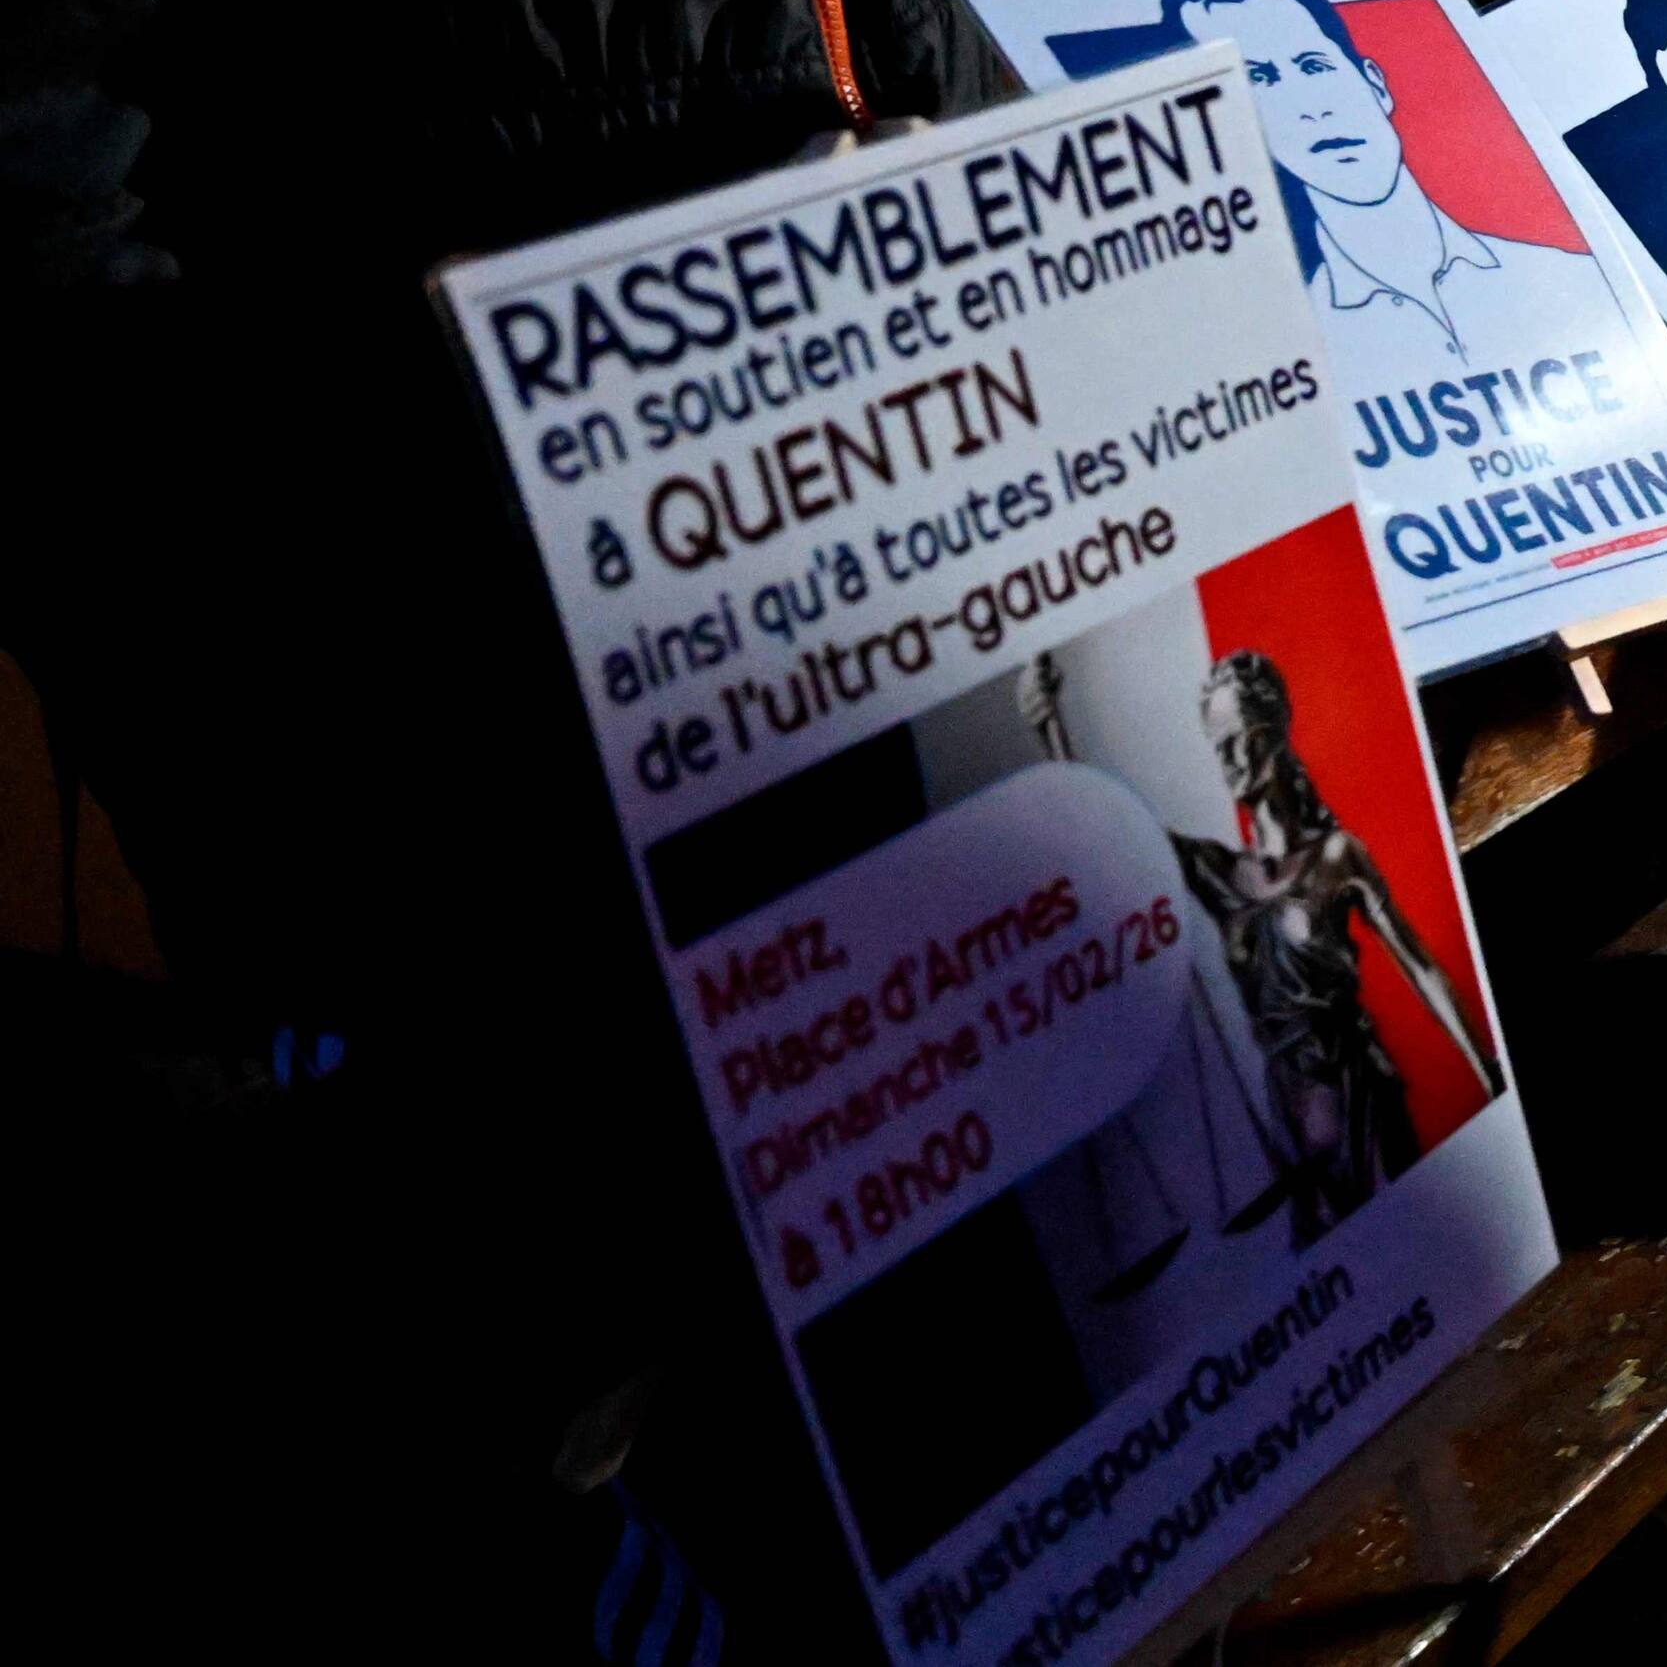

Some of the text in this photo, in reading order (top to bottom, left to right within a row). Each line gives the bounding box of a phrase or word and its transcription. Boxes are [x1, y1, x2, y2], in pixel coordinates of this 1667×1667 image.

[490, 87, 1225, 408] RASSEMBLEMENT
[542, 187, 1257, 484] en soutien et en hommage
[589, 349, 1038, 587] à QUENTIN
[605, 358, 1318, 704] ainsi qu'à toutes les victimes
[1354, 350, 1624, 469] JUSTICE
[1468, 442, 1554, 483] POUR
[636, 505, 1174, 793] de l'ultra-gauche
[695, 919, 846, 1028] Metz
[723, 875, 1081, 1112] Place d'Armes
[747, 895, 1179, 1195] Dimanche 15/02/26
[781, 1112, 990, 1290] à 18h00
[902, 1264, 1354, 1651] #justicepourQuentin
[1000, 1294, 1437, 1667] sticepourlesvictimes
